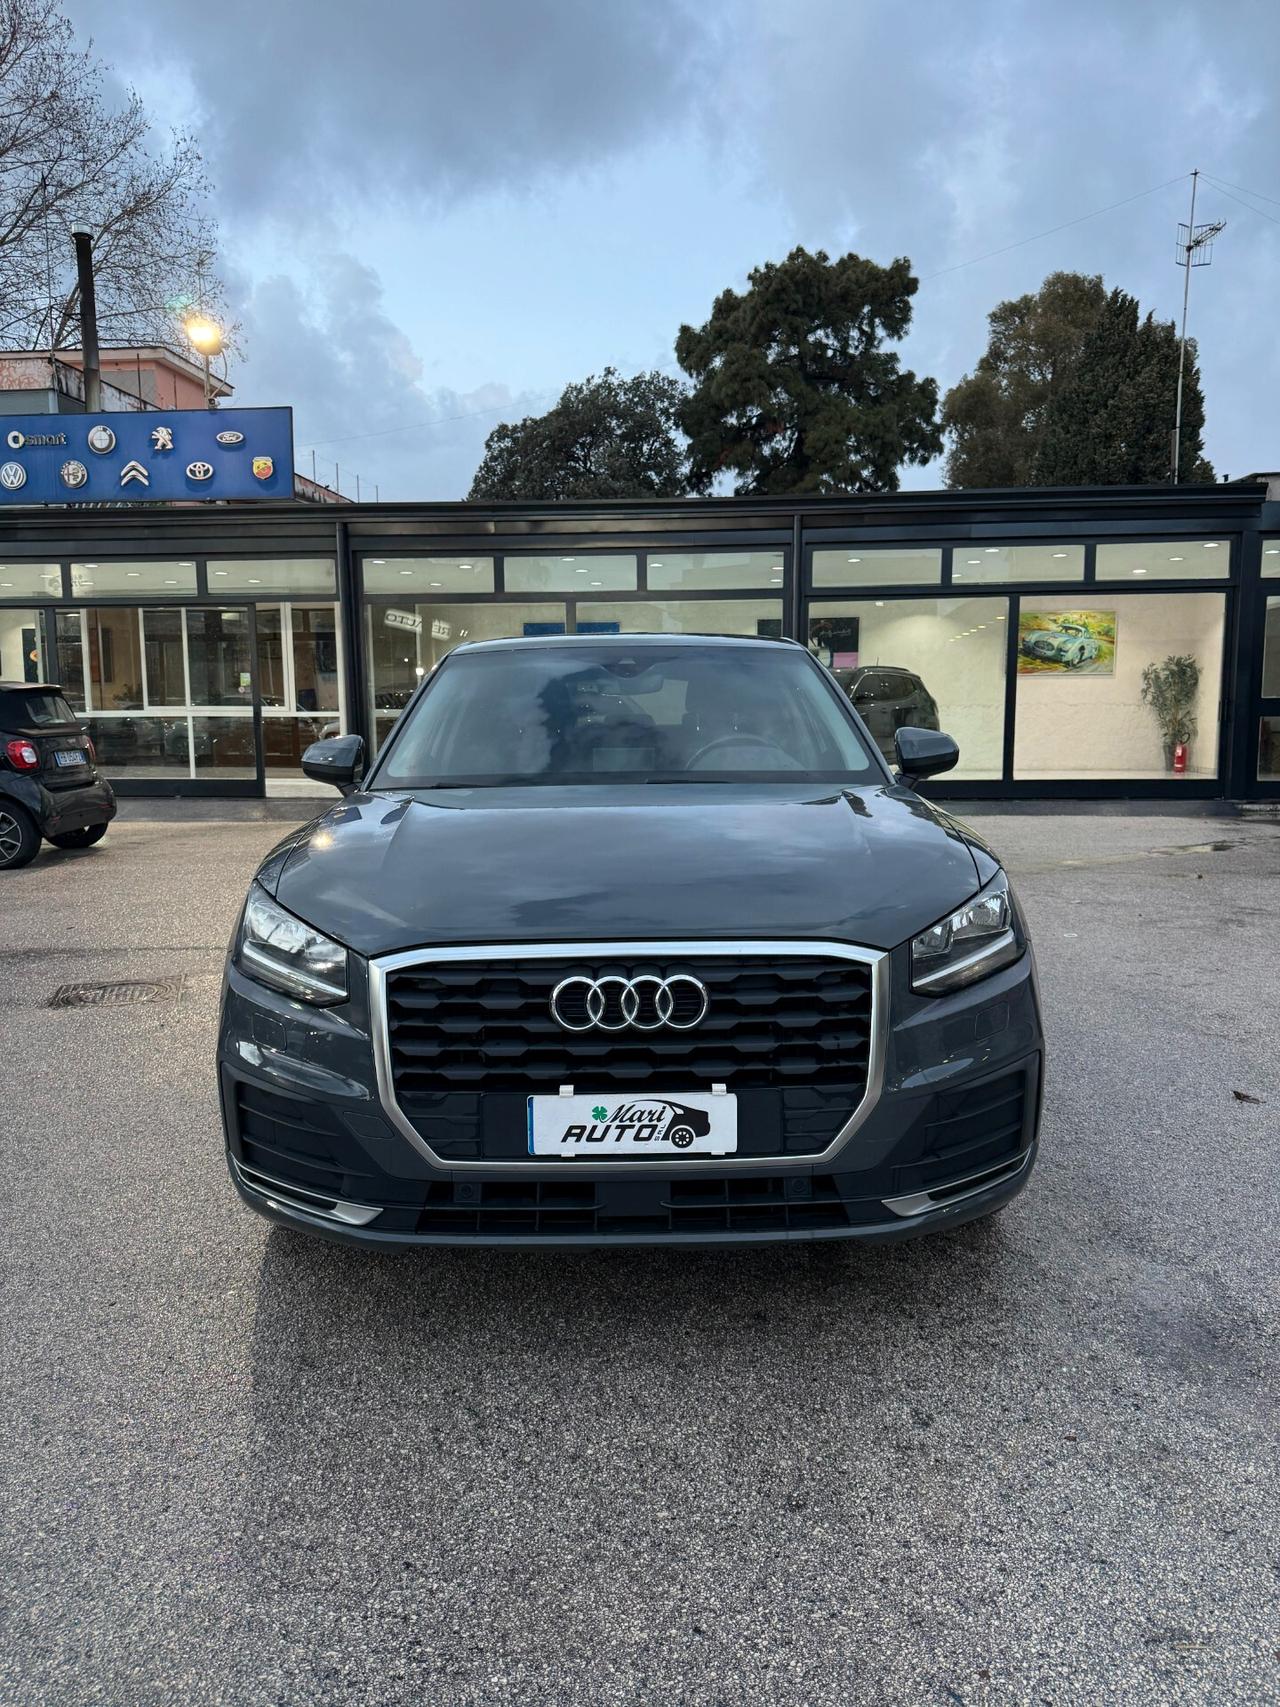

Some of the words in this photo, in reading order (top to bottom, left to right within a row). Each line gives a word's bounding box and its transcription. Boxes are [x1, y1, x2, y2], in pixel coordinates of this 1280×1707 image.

[27, 432, 67, 446] smart
[601, 1103, 668, 1124] Mari
[560, 1124, 659, 1143] AUTO
